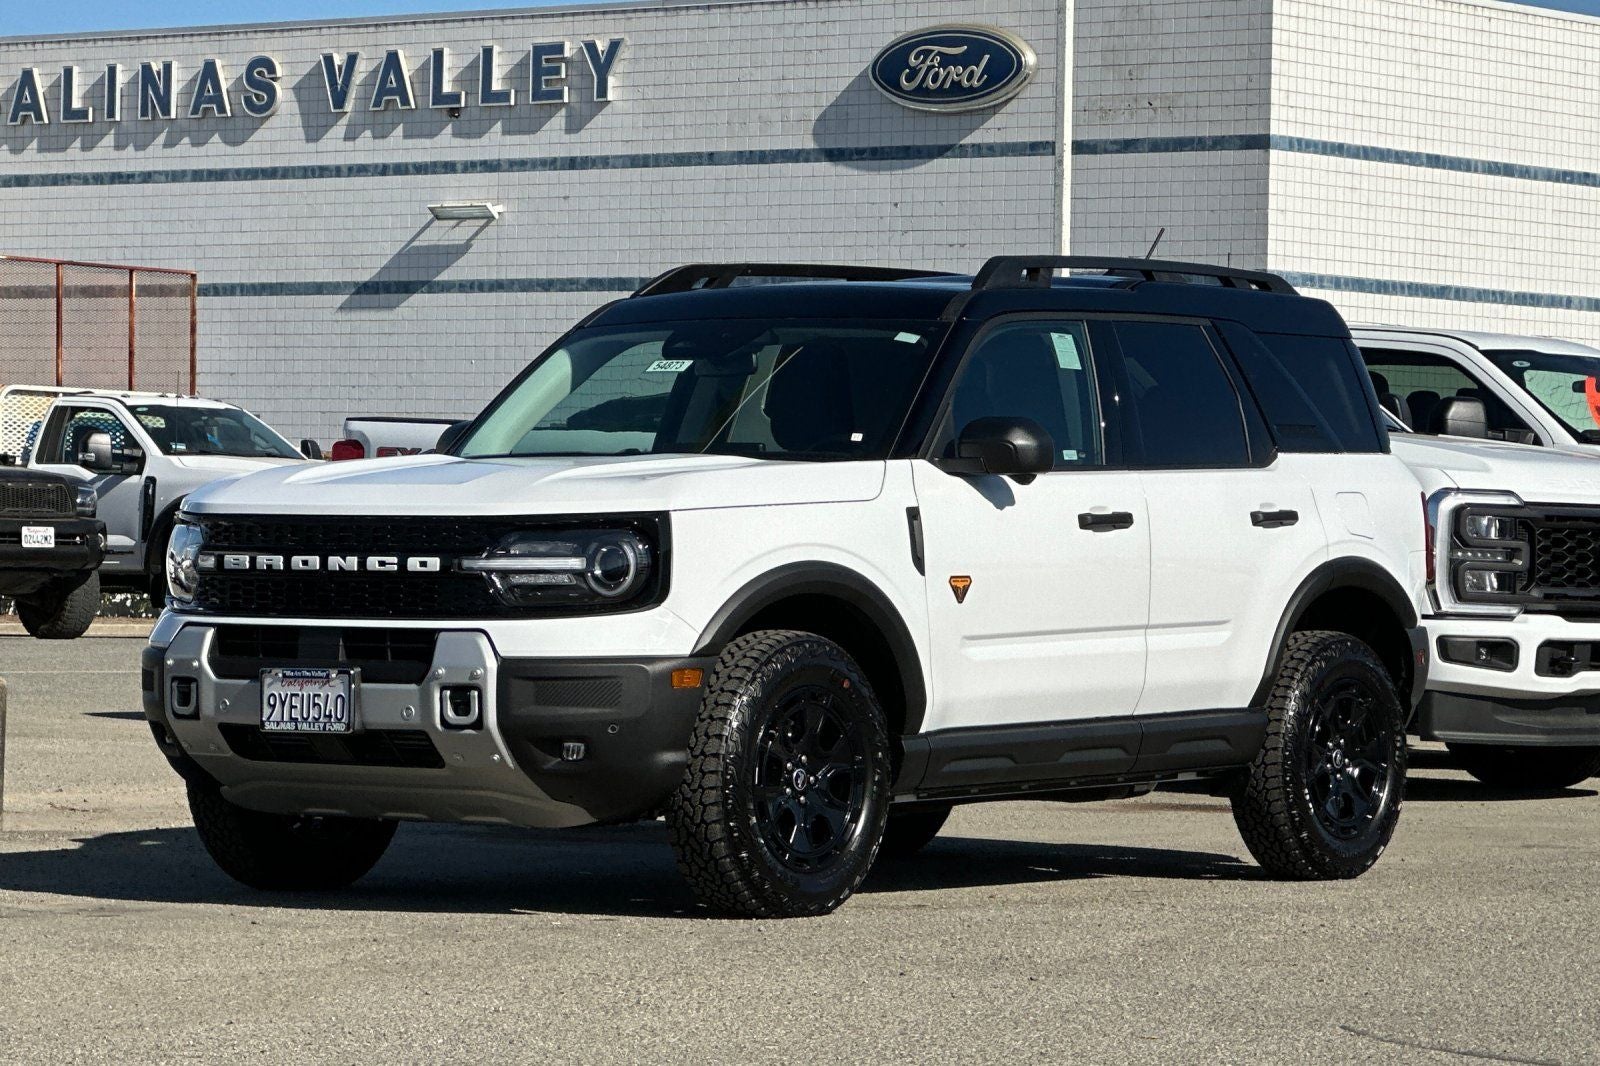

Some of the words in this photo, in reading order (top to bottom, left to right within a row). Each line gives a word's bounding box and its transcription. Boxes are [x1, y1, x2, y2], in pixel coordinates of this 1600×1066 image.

[900, 45, 990, 91] Ford
[6, 55, 282, 126] ALINAS
[320, 37, 625, 113] VALLEY
[652, 361, 685, 370] 54873
[223, 555, 441, 572] BRONCO
[265, 691, 346, 721] 9YEU540
[264, 721, 296, 731] SALINAS
[297, 722, 324, 731] VALLEY
[325, 723, 346, 731] FORD
